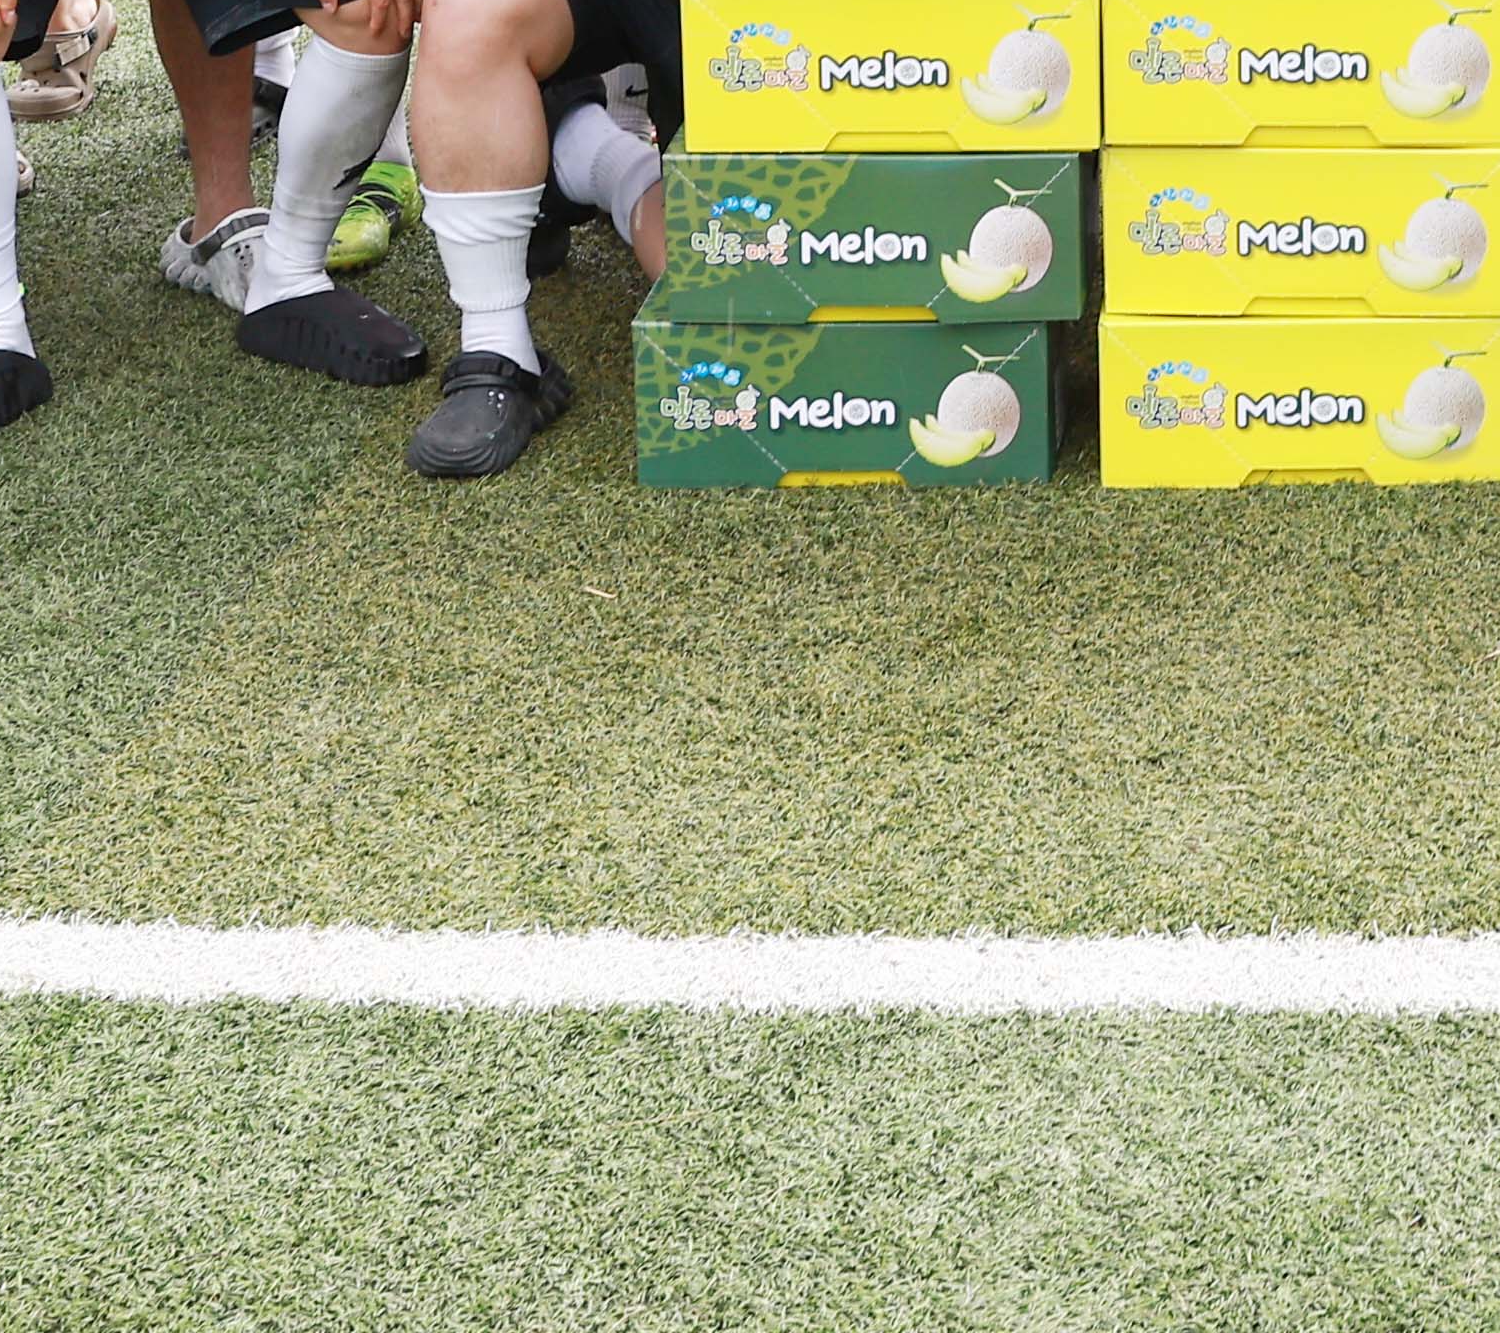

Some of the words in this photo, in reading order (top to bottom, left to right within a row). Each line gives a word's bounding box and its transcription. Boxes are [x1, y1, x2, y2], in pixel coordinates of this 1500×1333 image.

[820, 50, 949, 92] Melon
[1239, 44, 1368, 84] Melon
[801, 224, 928, 265] Melon
[1238, 218, 1366, 256] Melon
[770, 390, 897, 431] Melon
[1236, 388, 1365, 430] Melon
